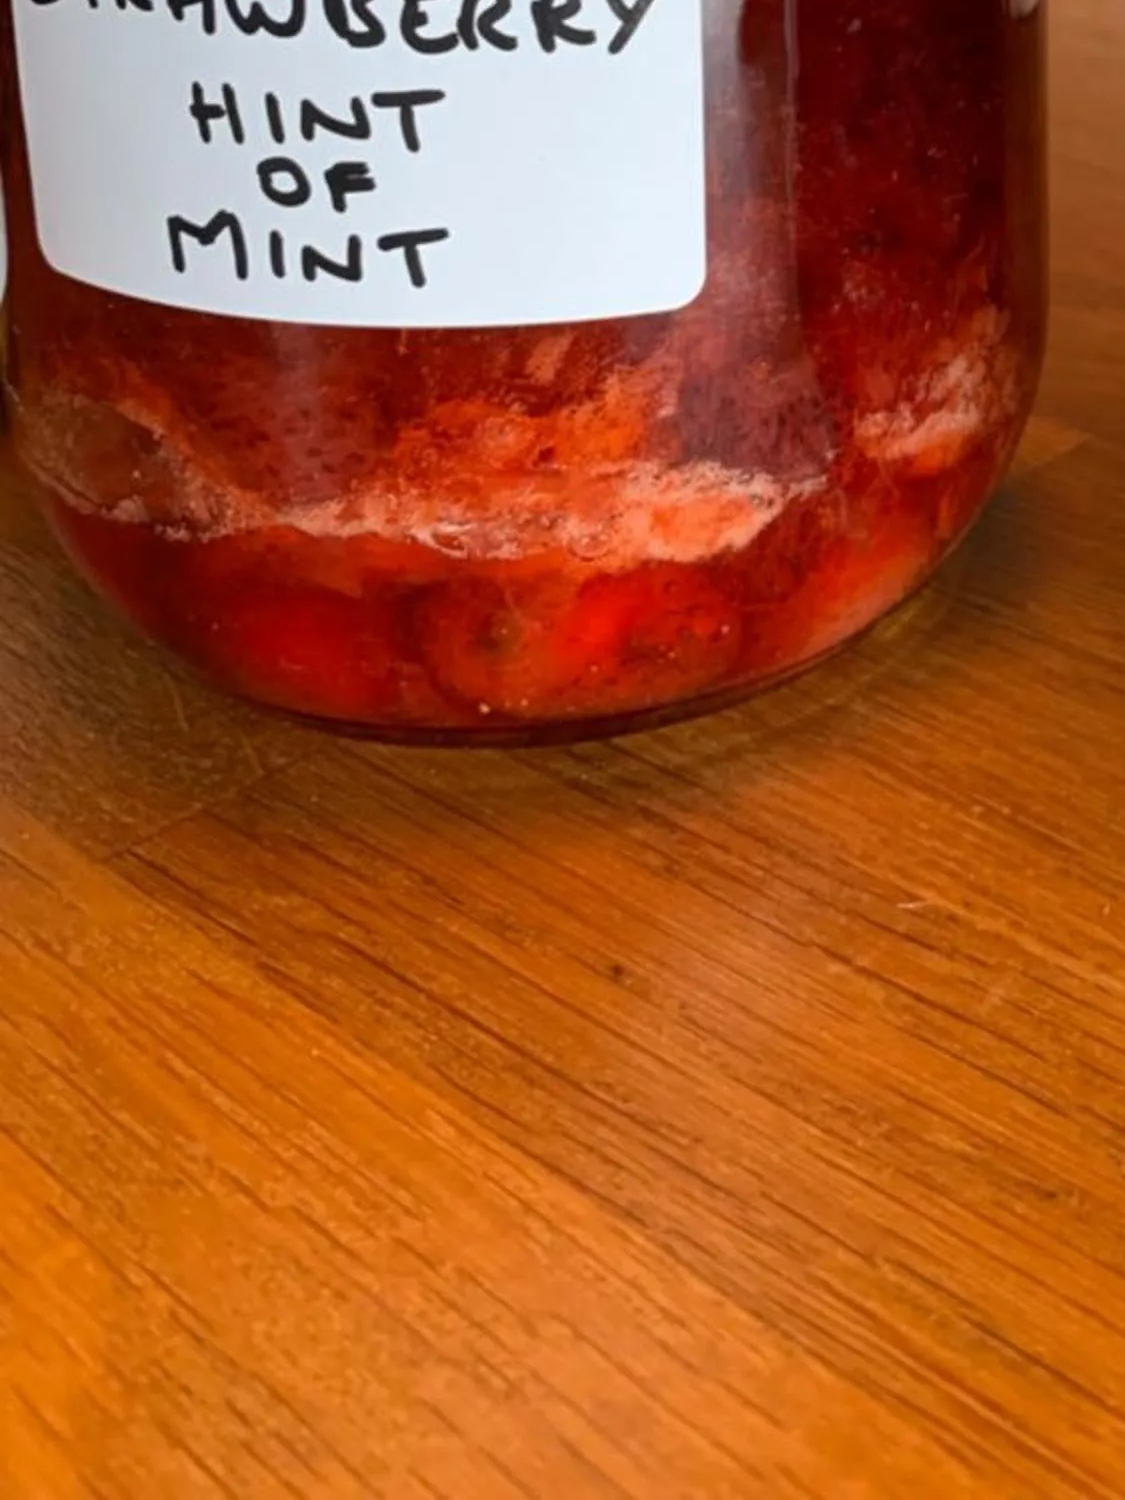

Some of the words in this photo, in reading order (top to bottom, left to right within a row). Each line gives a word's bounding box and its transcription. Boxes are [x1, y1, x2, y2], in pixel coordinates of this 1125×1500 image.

[189, 81, 445, 153] HINT
[256, 157, 375, 213] OF
[167, 210, 449, 288] MINT
